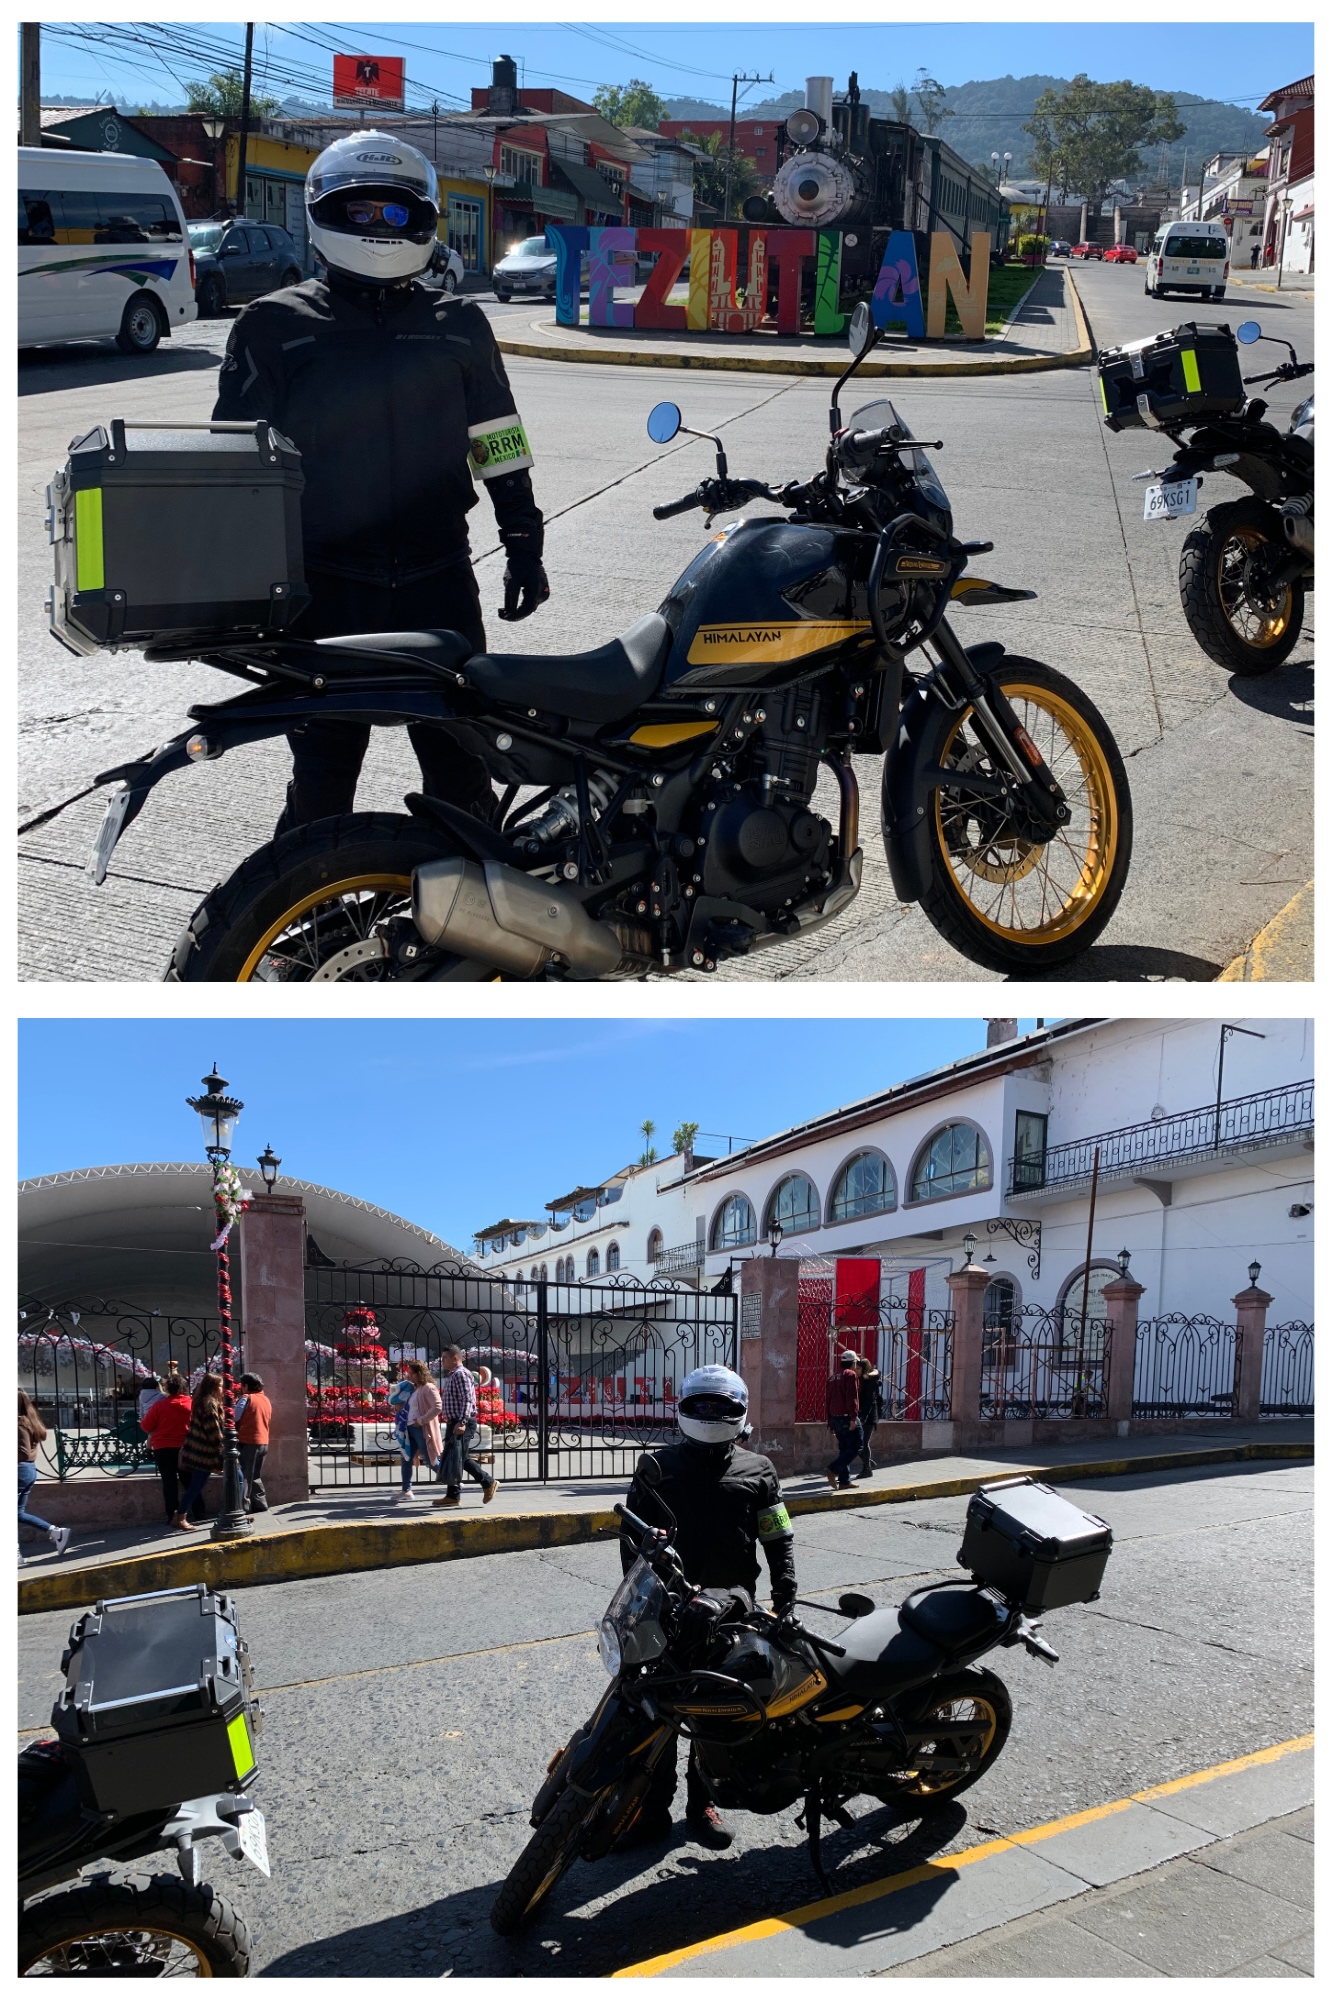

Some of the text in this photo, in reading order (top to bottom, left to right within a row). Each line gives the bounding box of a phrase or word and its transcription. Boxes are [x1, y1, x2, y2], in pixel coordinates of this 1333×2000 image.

[362, 154, 398, 163] HJC
[544, 225, 991, 340] TEZIUTLAN
[486, 426, 520, 440] MOTOTURISTA
[489, 433, 524, 456] RRM
[1150, 489, 1190, 511] 69KSG1
[703, 631, 781, 644] HIMALAYAN
